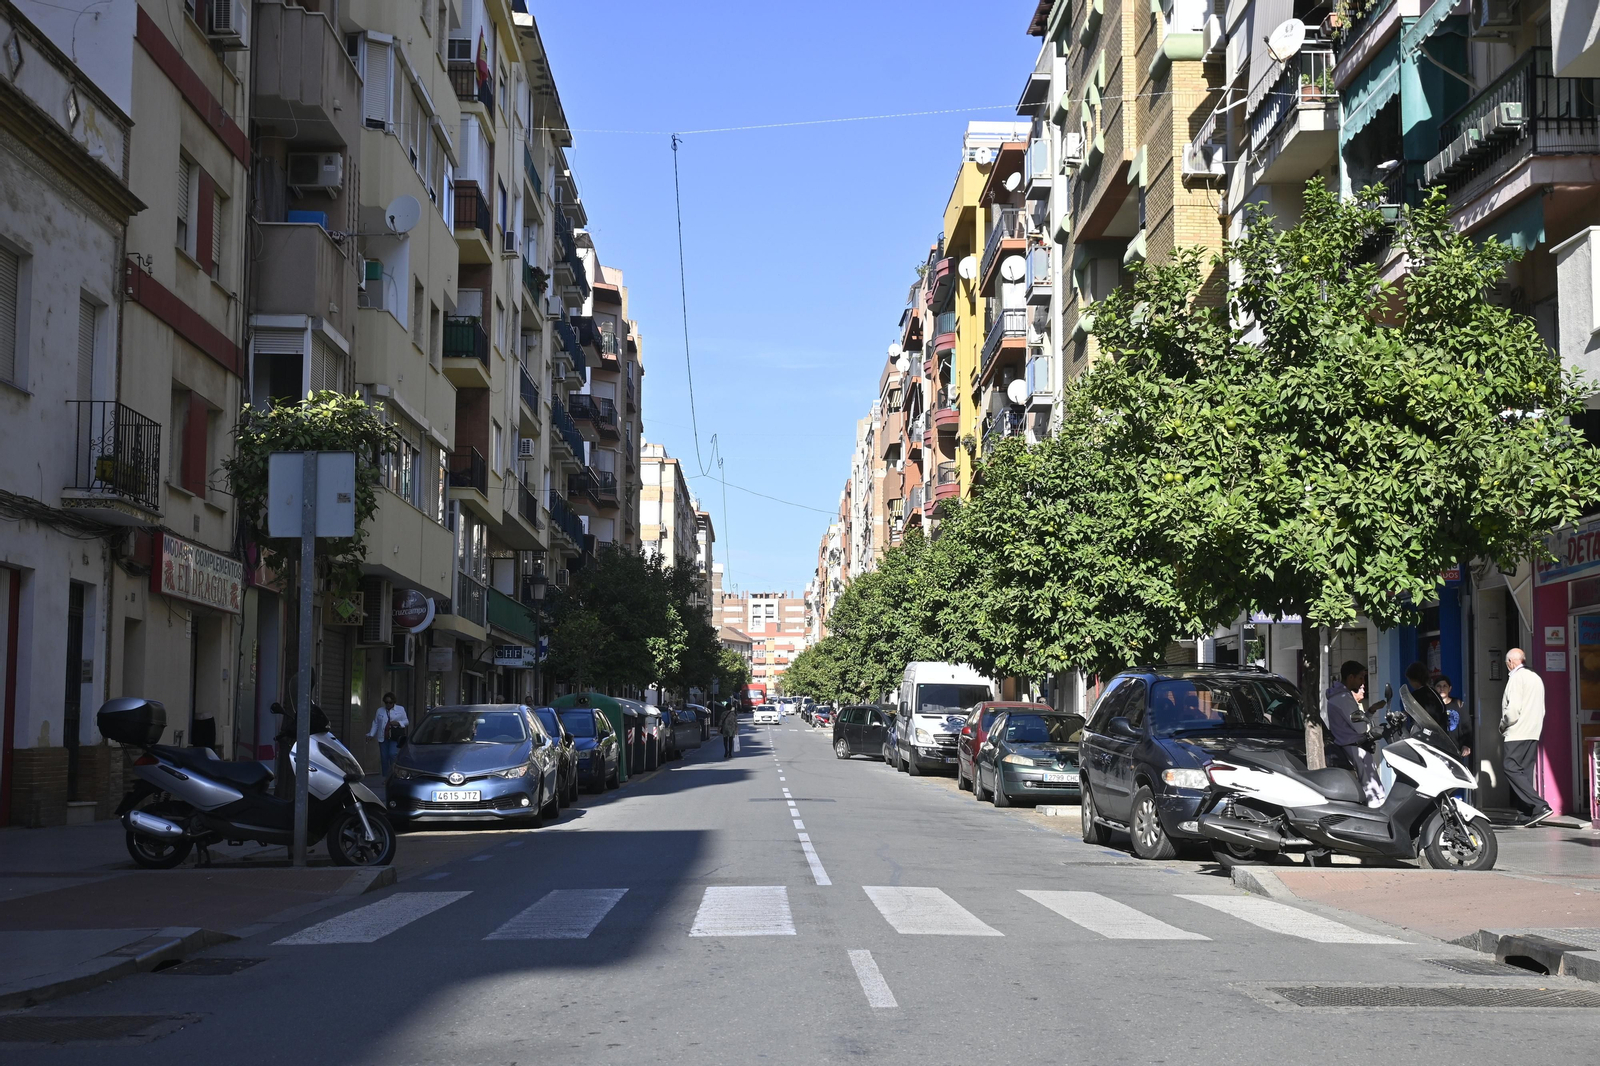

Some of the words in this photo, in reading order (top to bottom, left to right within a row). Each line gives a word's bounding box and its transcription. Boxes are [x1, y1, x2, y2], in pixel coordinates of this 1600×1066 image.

[164, 537, 188, 561] MODAS
[195, 549, 242, 580] COMPLEMENTOS
[178, 563, 190, 594] EL
[392, 607, 427, 617] Cruzcampo
[495, 649, 521, 658] CHF
[438, 792, 459, 800] 4615
[462, 792, 478, 800] JTZ
